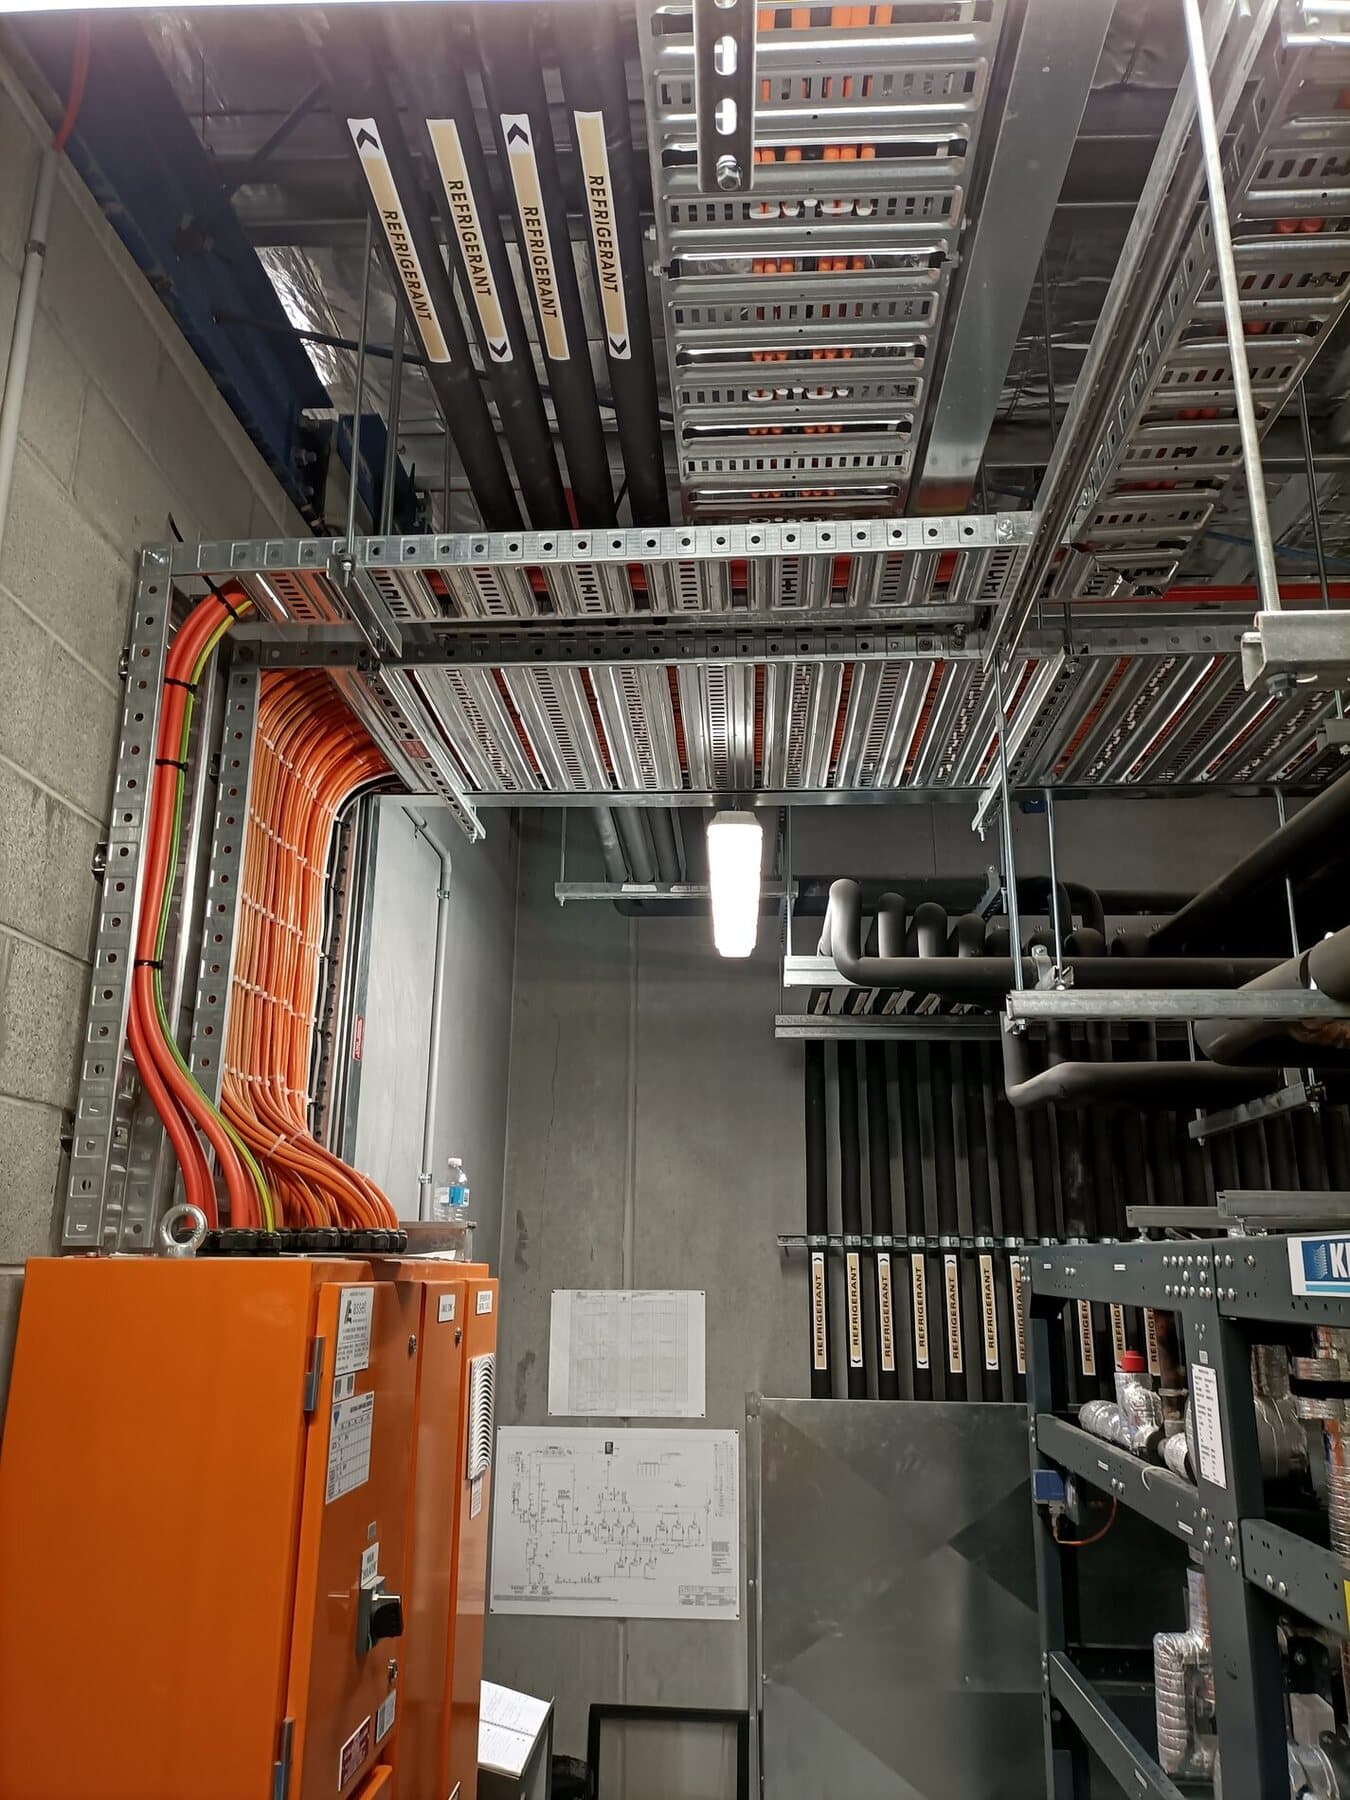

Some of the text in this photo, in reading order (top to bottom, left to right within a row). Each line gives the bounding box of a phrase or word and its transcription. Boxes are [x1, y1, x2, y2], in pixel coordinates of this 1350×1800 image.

[382, 209, 432, 321] REFRIGERANT
[448, 180, 492, 296] REFRIGERANT
[523, 206, 557, 318] REFRIGERANT
[588, 175, 618, 293] REFRIGERANT
[815, 1275, 825, 1356] REFRIGERANT
[850, 1266, 860, 1346] REFRIGERANT
[882, 1276, 892, 1357] REFRIGERANT
[915, 1267, 926, 1347] REFRIGERANT
[948, 1278, 959, 1359] REFRIGERANT
[983, 1268, 994, 1348] REFRIGERANT
